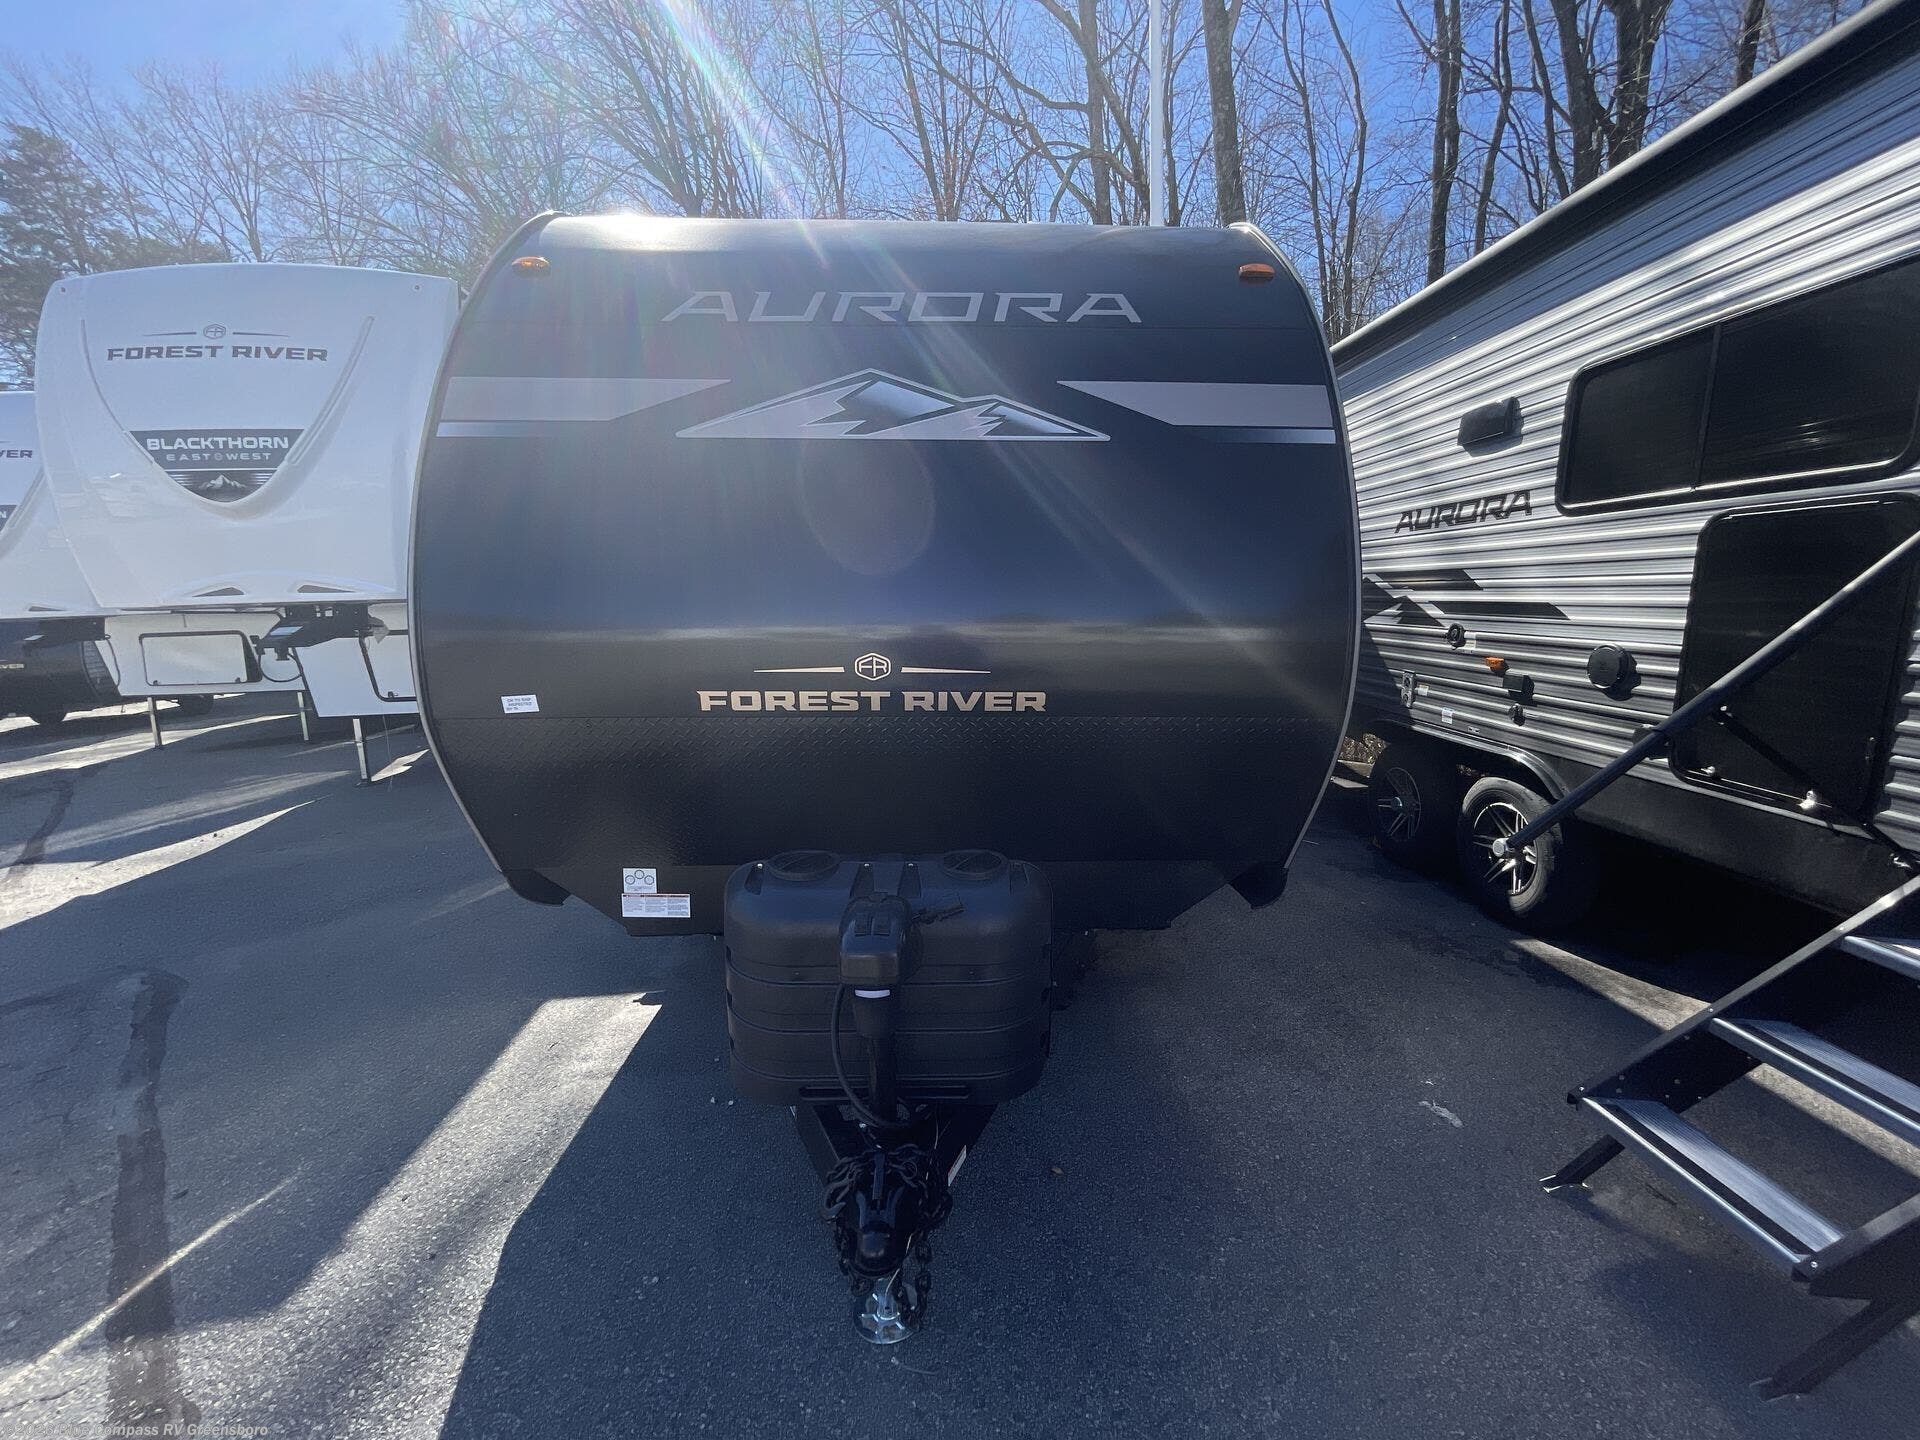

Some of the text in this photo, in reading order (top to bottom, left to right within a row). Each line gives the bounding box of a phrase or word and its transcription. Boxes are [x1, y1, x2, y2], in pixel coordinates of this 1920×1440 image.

[660, 290, 1142, 324] AURORA
[107, 345, 328, 361] FOREST RIVER
[146, 436, 289, 451] BLACKTHORN
[166, 452, 272, 462] EAST WEST
[1394, 490, 1532, 534] AURORA
[697, 690, 1047, 713] FOREST RIVER
